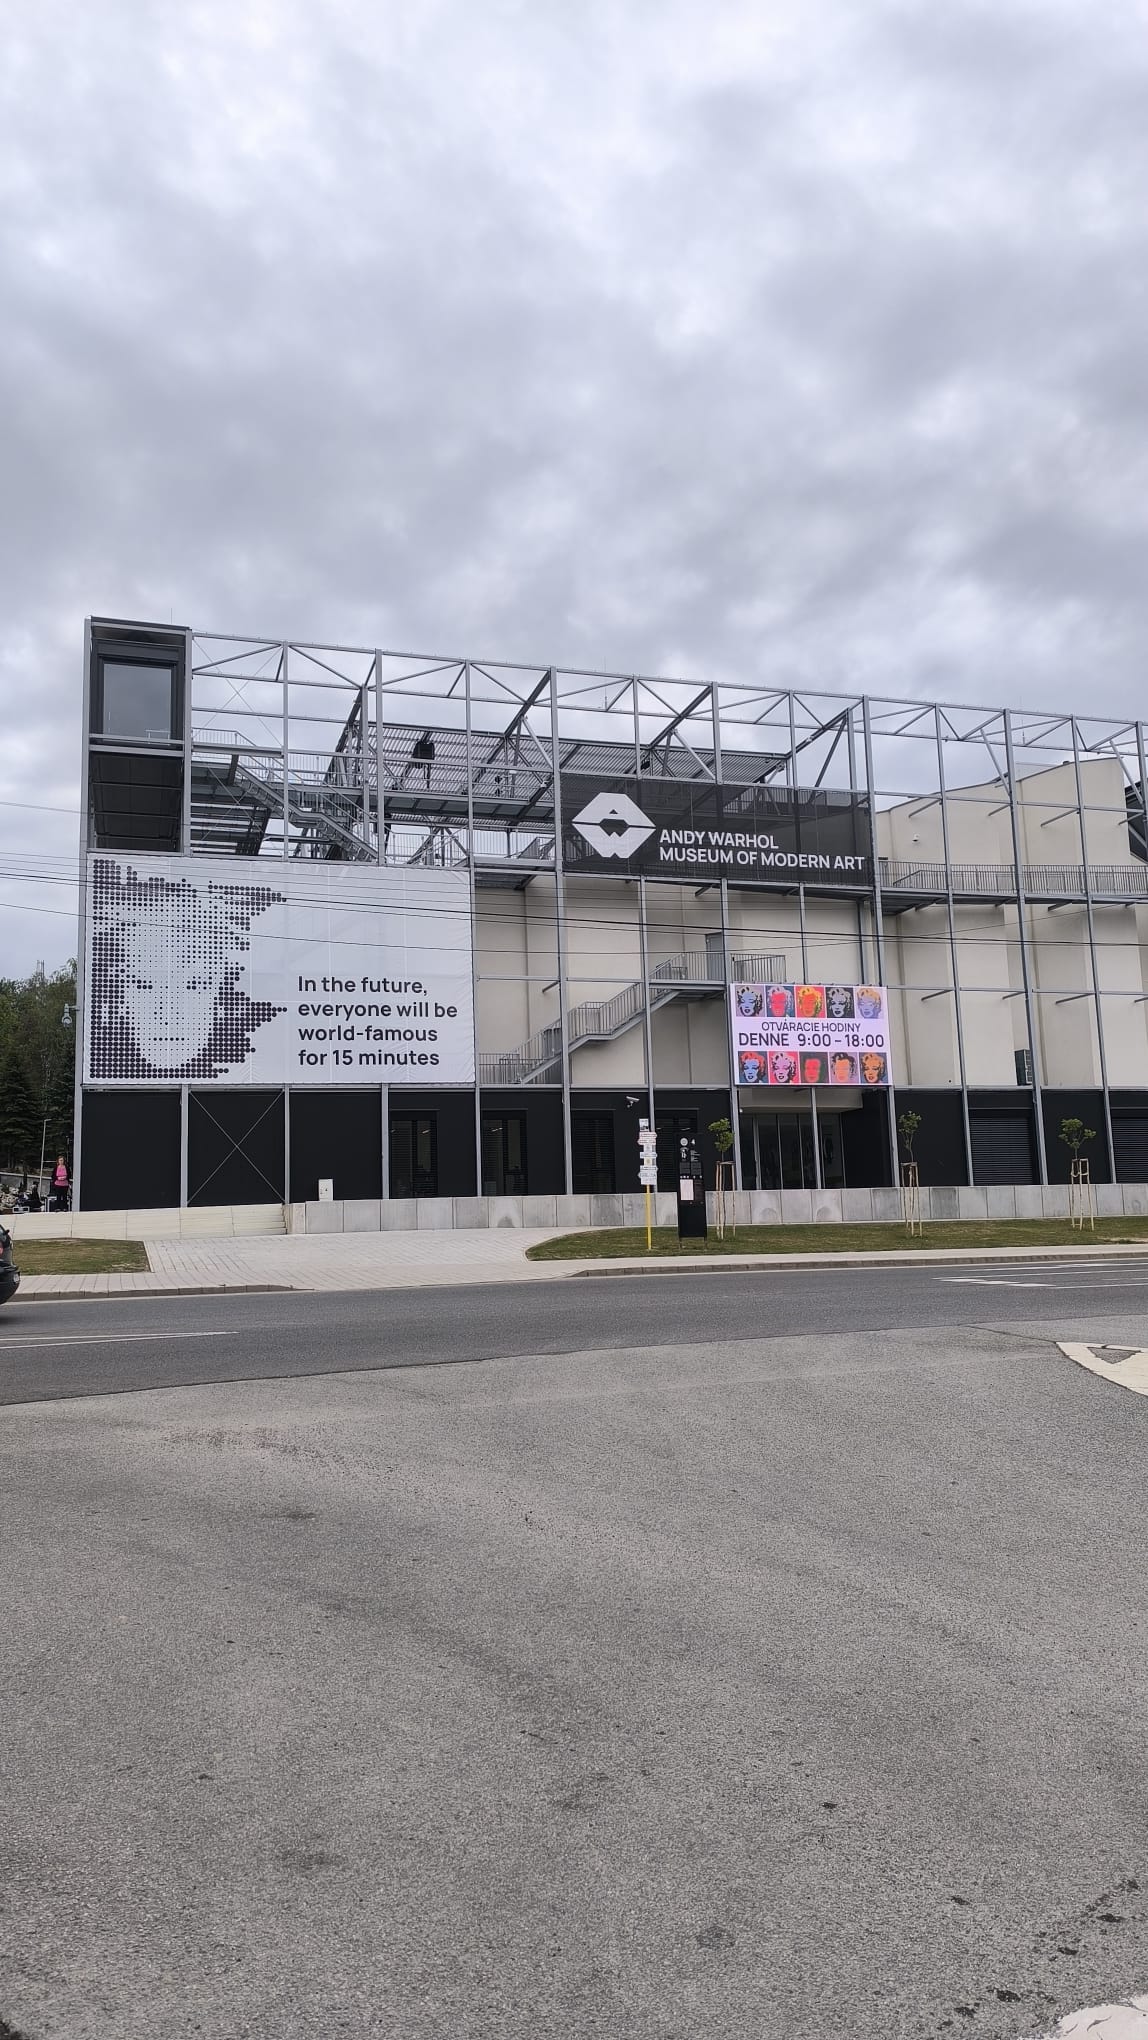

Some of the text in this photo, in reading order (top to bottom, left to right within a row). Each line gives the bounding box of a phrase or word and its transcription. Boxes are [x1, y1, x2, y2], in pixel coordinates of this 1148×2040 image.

[660, 829, 779, 849] ANDY WARHOL
[660, 847, 865, 870] MUSEUM OF MODERN ART
[298, 975, 428, 996] In the future,
[298, 1002, 458, 1021] everyone will be
[298, 1025, 438, 1041] world-famous
[761, 1018, 861, 1032] OTVÁRACIE HODINY
[738, 1033, 790, 1046] DENNE
[797, 1034, 831, 1046] 9:00
[845, 1034, 884, 1047] 18:00
[298, 1049, 440, 1066] for 15 minutes
